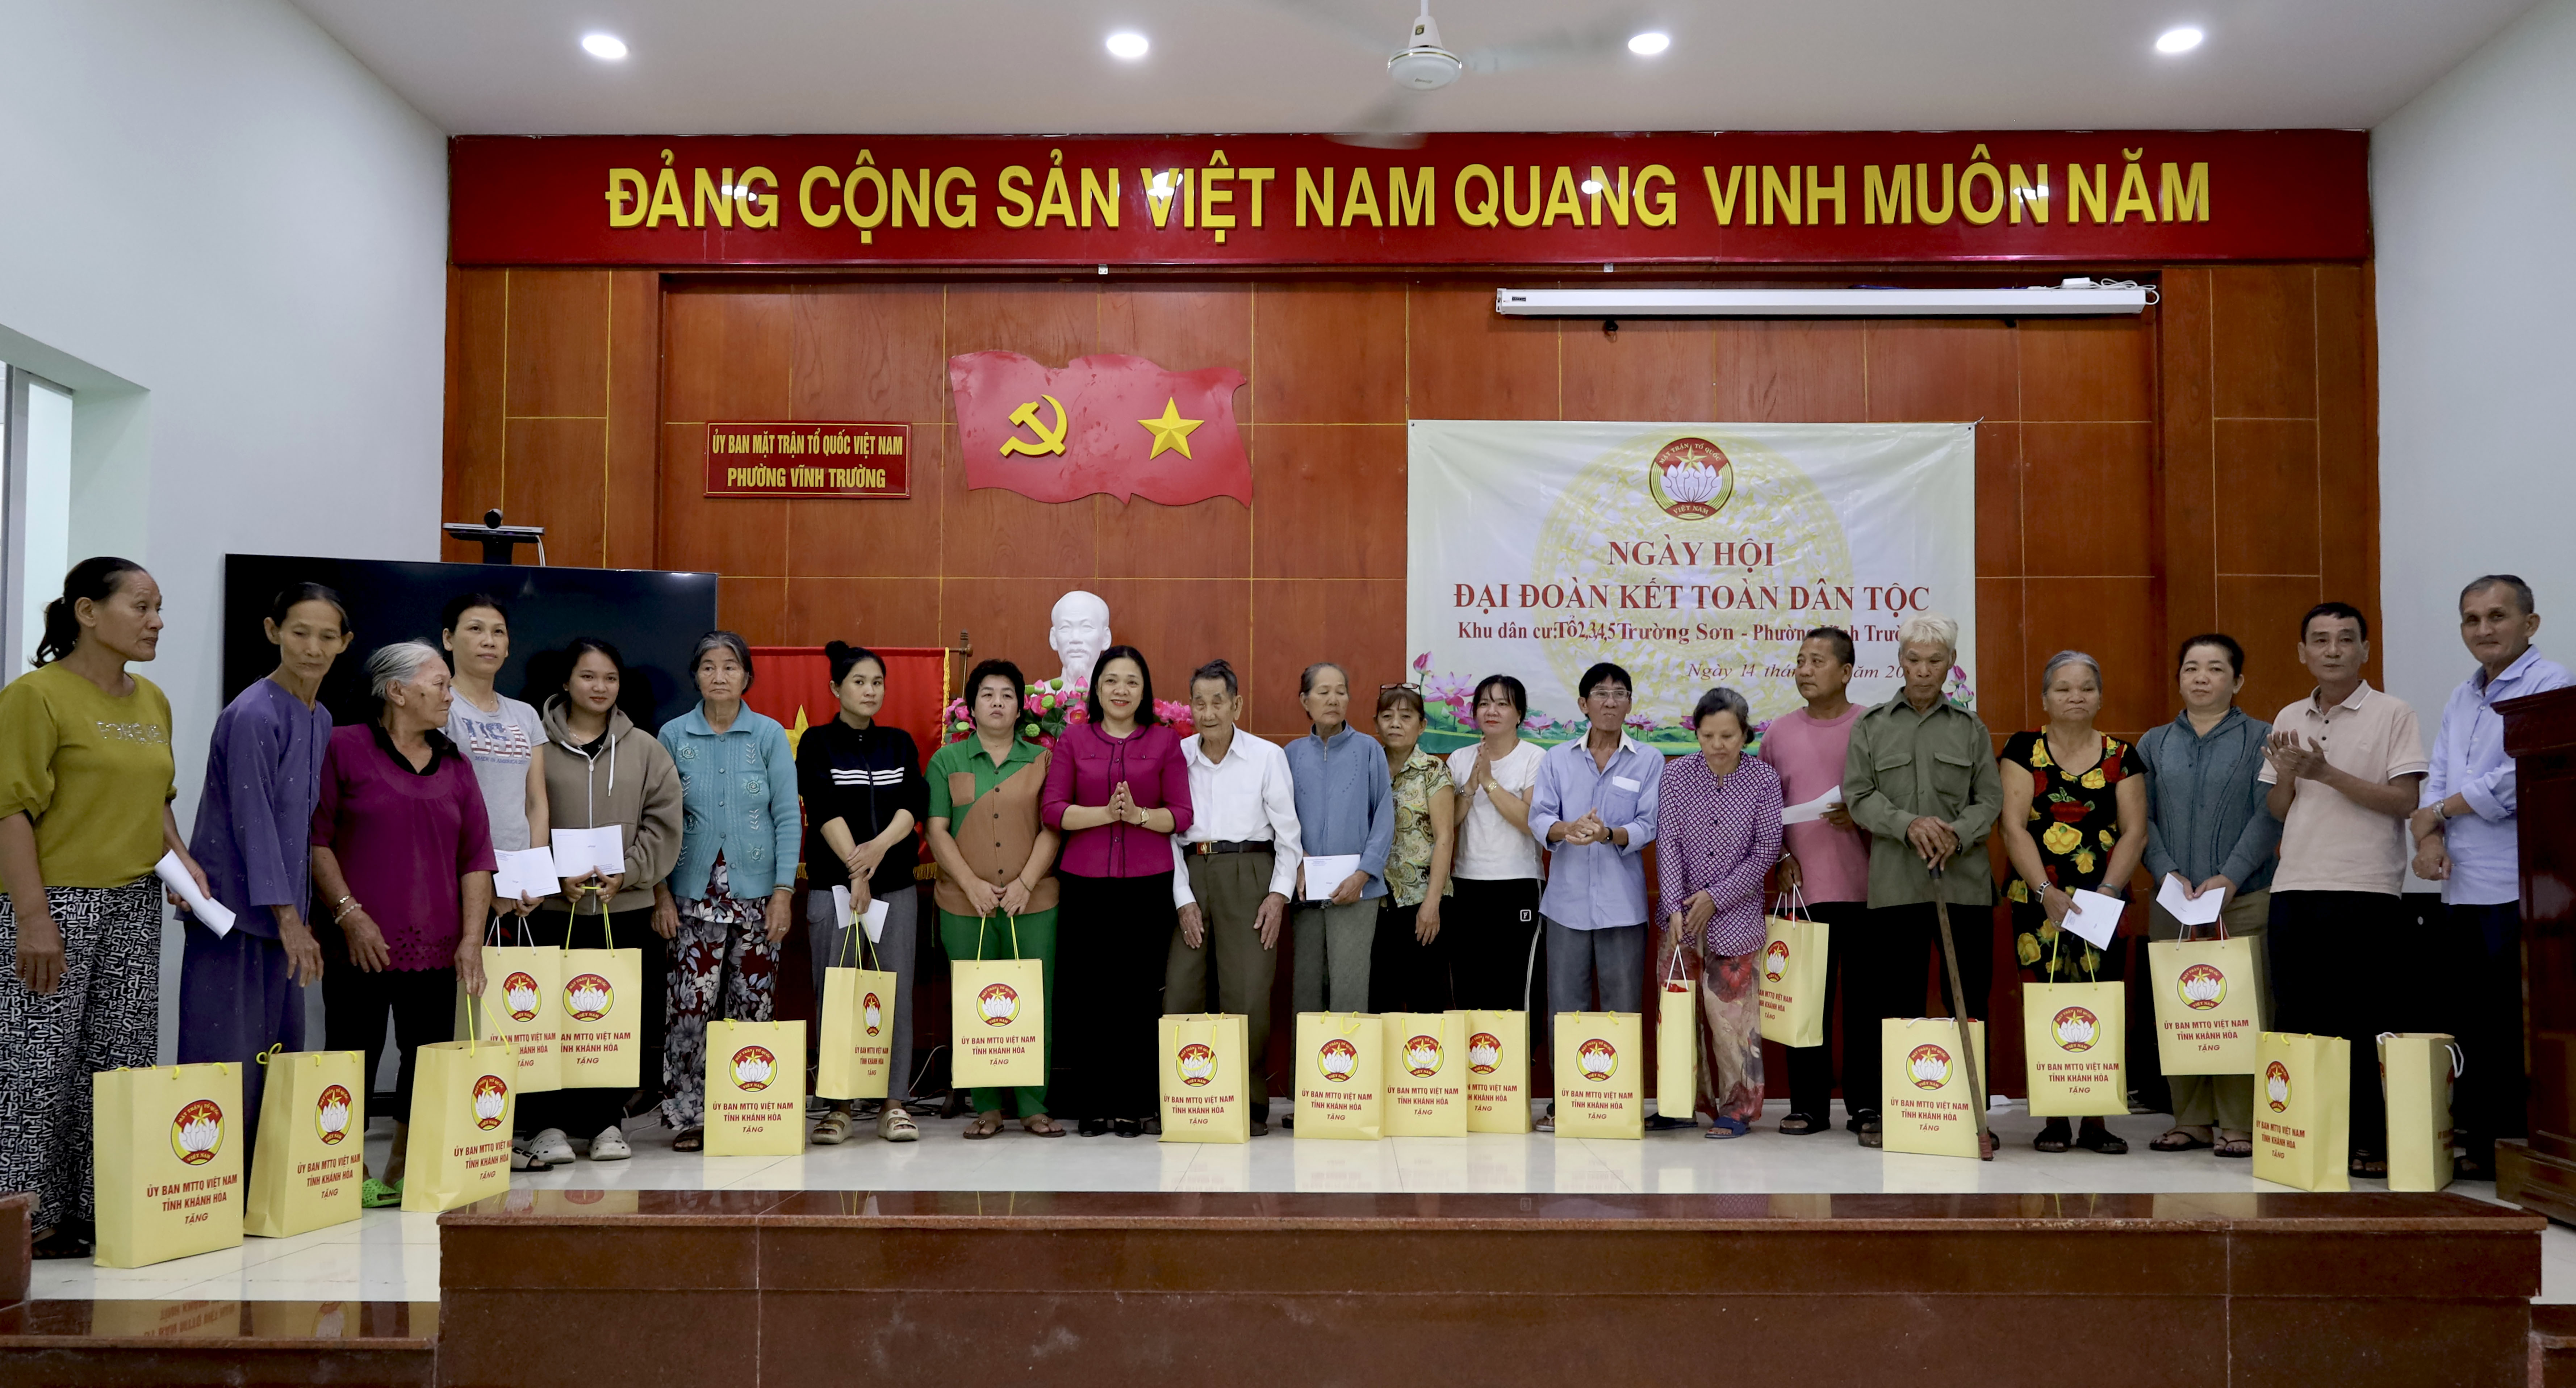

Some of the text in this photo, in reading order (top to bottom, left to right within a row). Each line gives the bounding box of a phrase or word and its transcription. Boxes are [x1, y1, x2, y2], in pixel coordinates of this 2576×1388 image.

[605, 143, 2209, 244] ĐẢNG CỘNG SẢN VIỆT NAM QUANG VINH MUÔN NĂM
[712, 428, 903, 459] ỦY BAN MẶT TRẬN TỔ QUỐC VIỆT NAM
[1659, 451, 1670, 464] MẶT
[1670, 443, 1689, 453] TRẬN
[1705, 447, 1721, 461] QUỐC
[727, 464, 886, 488] PHƯỜNG VĨNH TRƯỜNG
[1673, 505, 1709, 515] VIỆT NAM
[1607, 534, 1775, 574] NGÀY HỘI
[1453, 576, 1929, 618] ĐẠI ĐOÀN KẾT TOÀN DÂN TỘC
[1458, 621, 1492, 639] Khu
[1498, 621, 1527, 639] dân
[1617, 622, 1690, 645] Trường
[1696, 623, 1734, 640] Sơn
[1688, 664, 1732, 680] Ngày
[1740, 664, 1755, 678] 14
[1853, 666, 1878, 678] ăm
[1885, 665, 1904, 678] 20
[461, 717, 531, 759] USA
[2164, 1020, 2173, 1030] ỦY
[2214, 1019, 2228, 1029] VIỆT
[962, 1036, 969, 1044] ỦY
[1006, 1035, 1019, 1044] VIỆT
[989, 1046, 1010, 1054] KHÁNH
[2198, 1044, 2220, 1053] TẶNG
[990, 1058, 1008, 1066] TẶNG
[2037, 1061, 2045, 1070] ỦY
[2086, 1062, 2100, 1072] VIỆT
[1302, 1088, 1309, 1097] ỦY
[1343, 1092, 1356, 1101] VIỆT
[1388, 1085, 1395, 1094] ỦY
[1430, 1086, 1442, 1096] VIỆT
[1562, 1088, 1569, 1096] ỦY
[1604, 1091, 1617, 1100] VIỆT
[2069, 1086, 2090, 1095] TẶNG
[1164, 1094, 1170, 1102] ỦY
[1204, 1095, 1217, 1104] VIỆT
[1891, 1096, 1899, 1106] ỦY
[1936, 1101, 1950, 1111] VIỆT
[713, 1101, 721, 1110] ỦY
[761, 1101, 774, 1111] VIỆT
[742, 1112, 765, 1121] KHÁNH
[1327, 1113, 1346, 1121] TẶNG
[1919, 1111, 1941, 1120] KHÁNH
[743, 1125, 763, 1134] TẶNG
[1920, 1123, 1939, 1132] TẶNG
[308, 1162, 319, 1172] BAN
[321, 1159, 336, 1170] MTTQ
[338, 1155, 349, 1167] VIỆT
[351, 1153, 360, 1164] NAM
[147, 1174, 237, 1197] ỦY BAN MTTQ VIỆT NAM
[185, 1195, 211, 1208] KHÁNH
[185, 1213, 208, 1225] TẶNG
